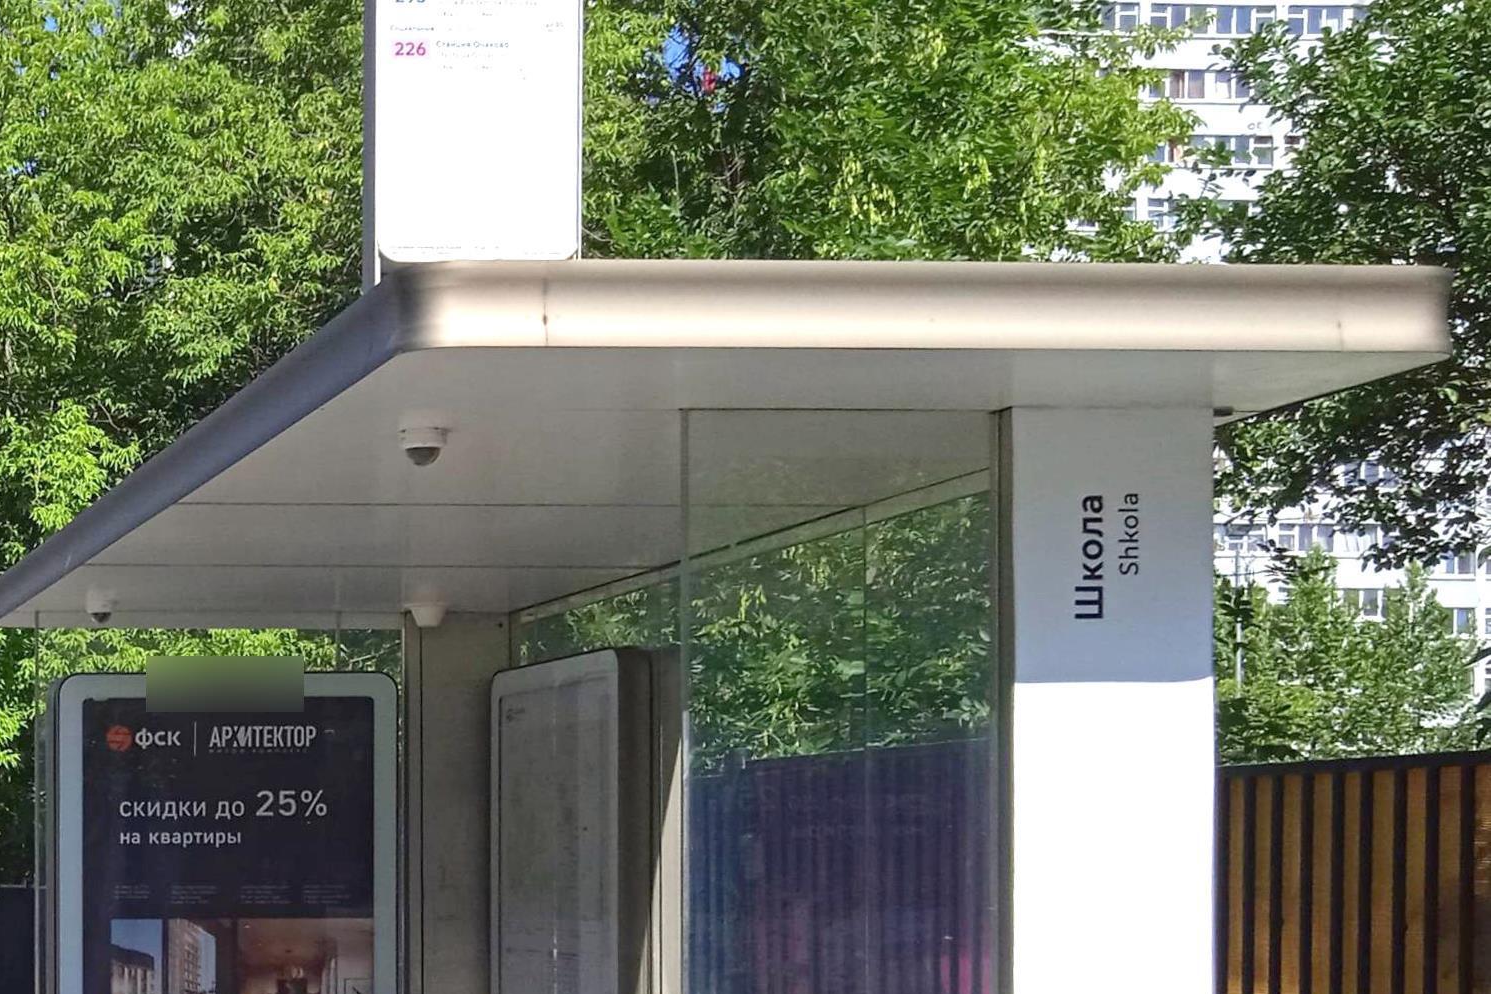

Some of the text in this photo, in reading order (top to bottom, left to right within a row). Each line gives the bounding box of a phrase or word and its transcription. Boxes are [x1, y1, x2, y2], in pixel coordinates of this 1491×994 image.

[395, 41, 426, 57] 226
[1118, 493, 1139, 575] Shkola
[1075, 495, 1104, 619] Школа
[119, 789, 328, 821] скидки до 25%
[119, 831, 242, 848] на квартиры
